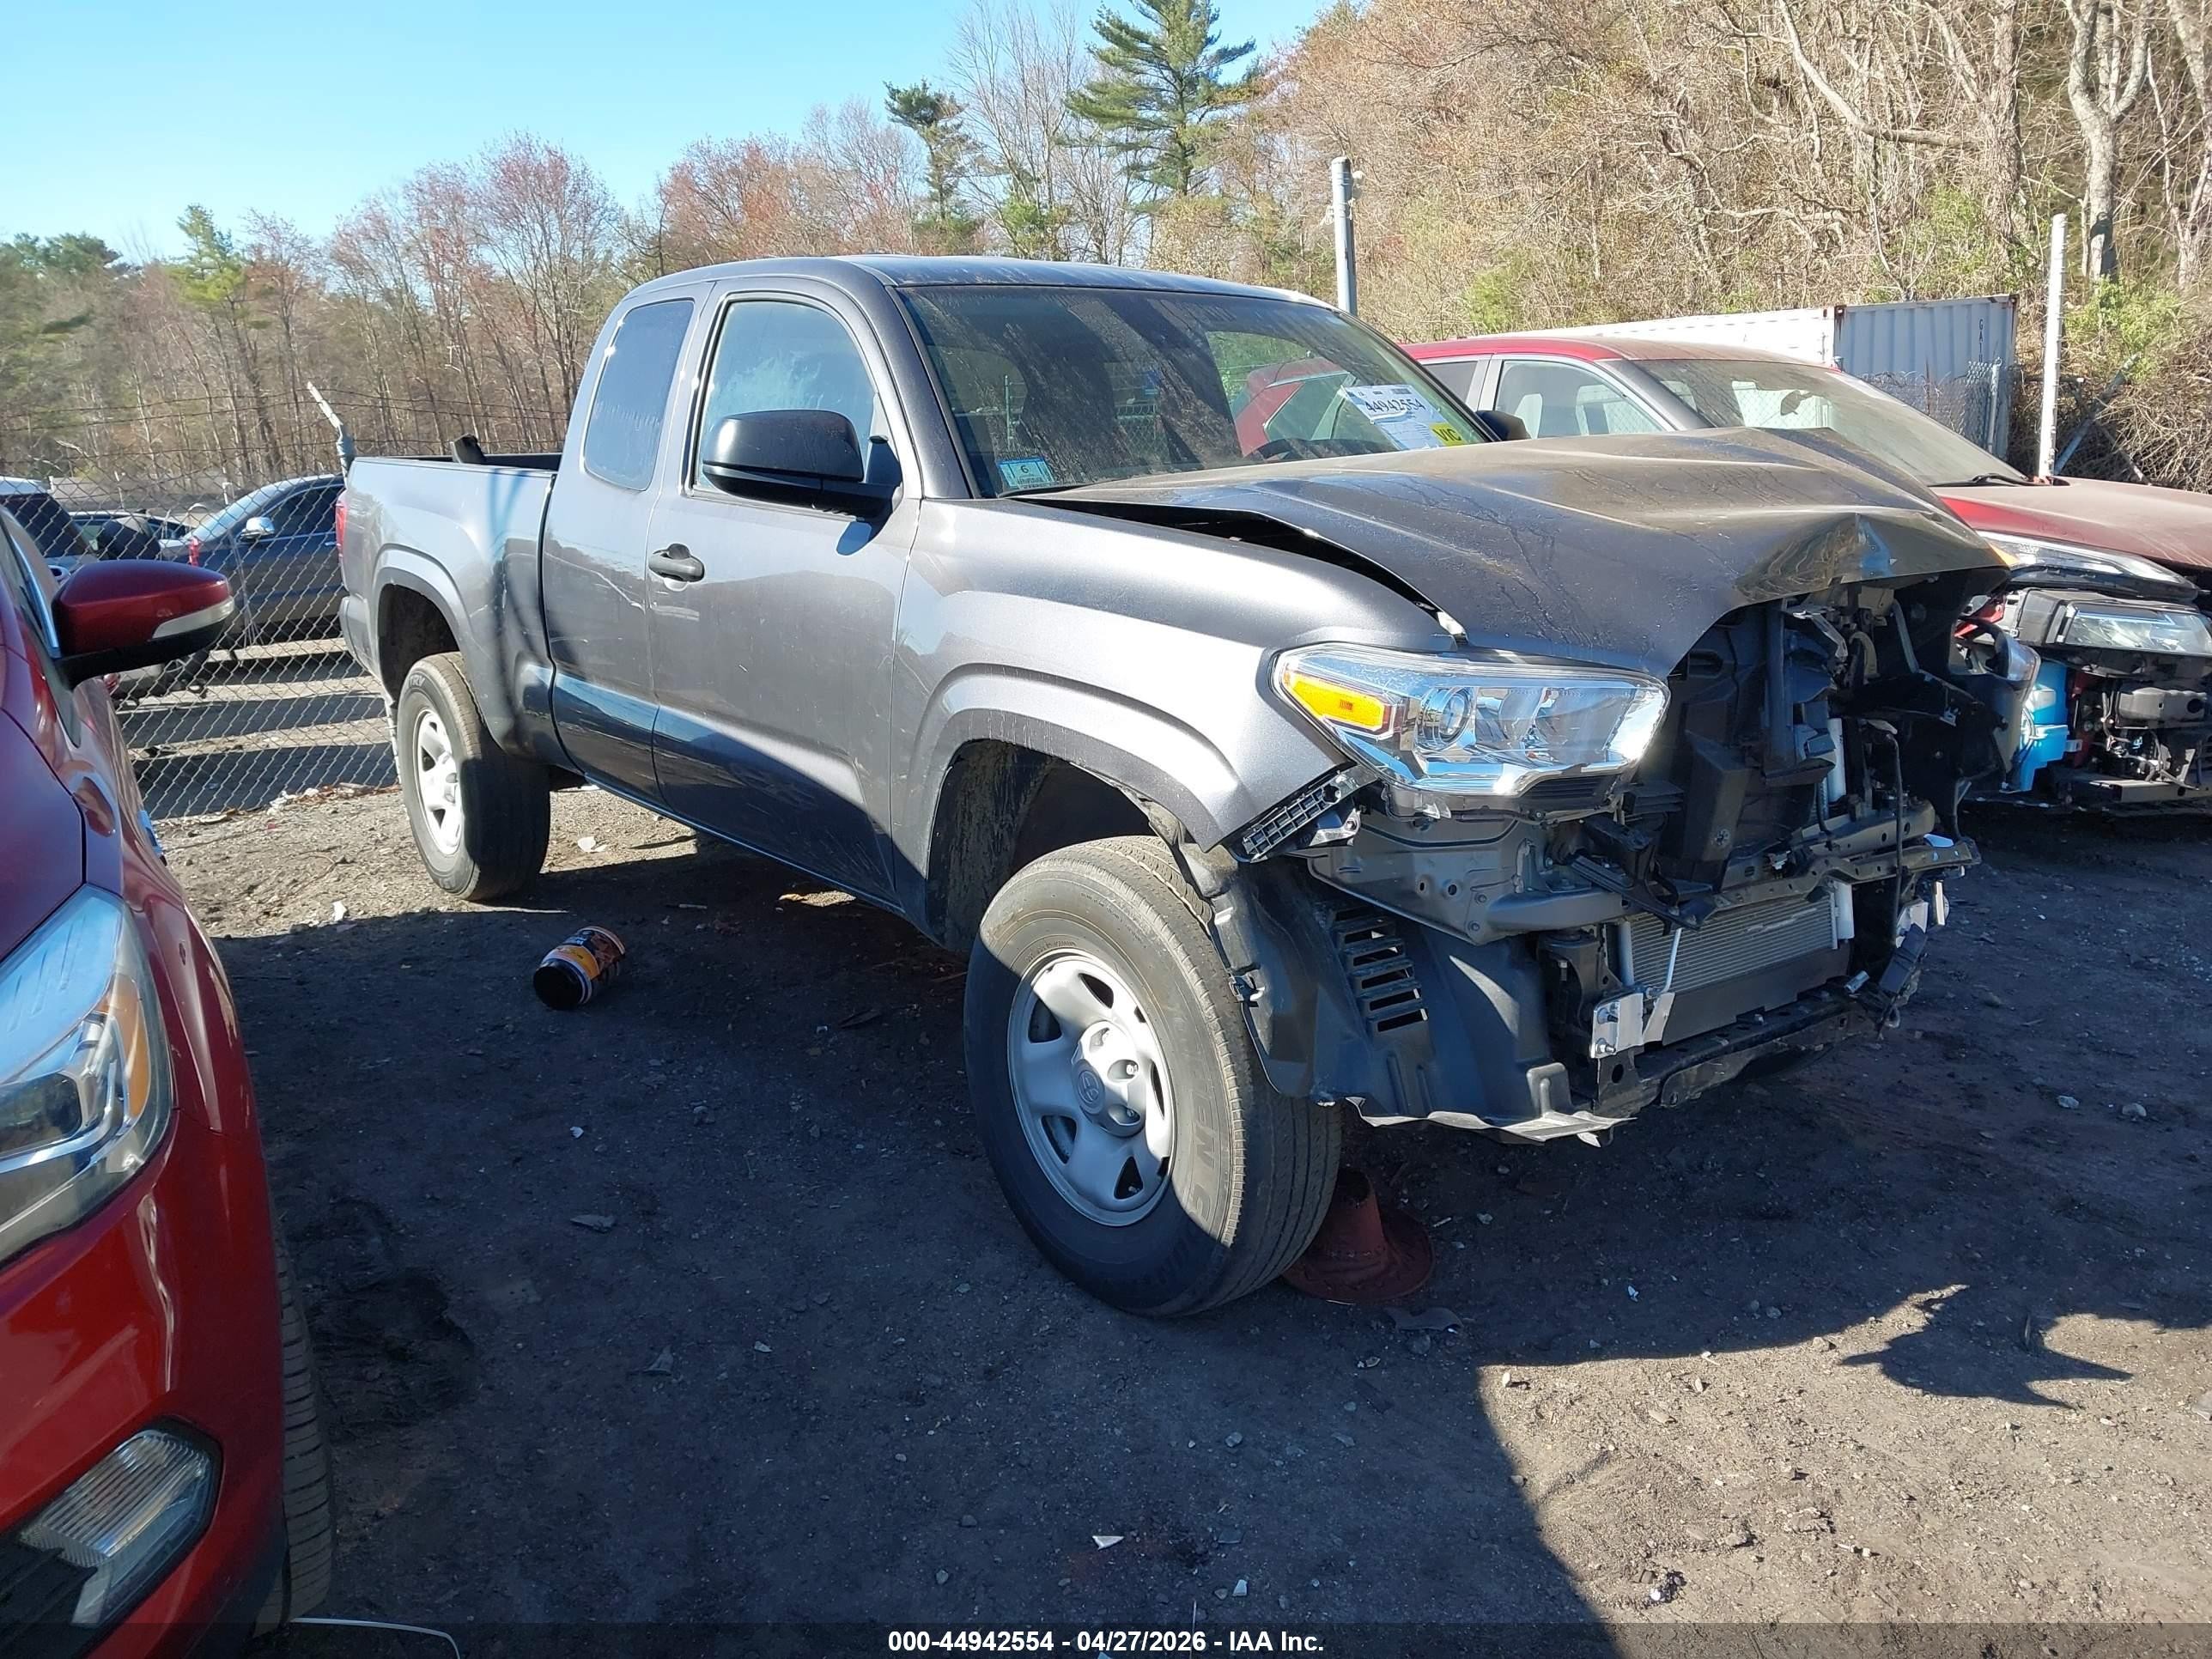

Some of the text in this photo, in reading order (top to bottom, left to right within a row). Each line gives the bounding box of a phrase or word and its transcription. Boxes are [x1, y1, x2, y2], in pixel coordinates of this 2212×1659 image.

[1364, 398, 1426, 413] 44942554
[1432, 428, 1462, 441] VIC
[1020, 465, 1030, 474] 6
